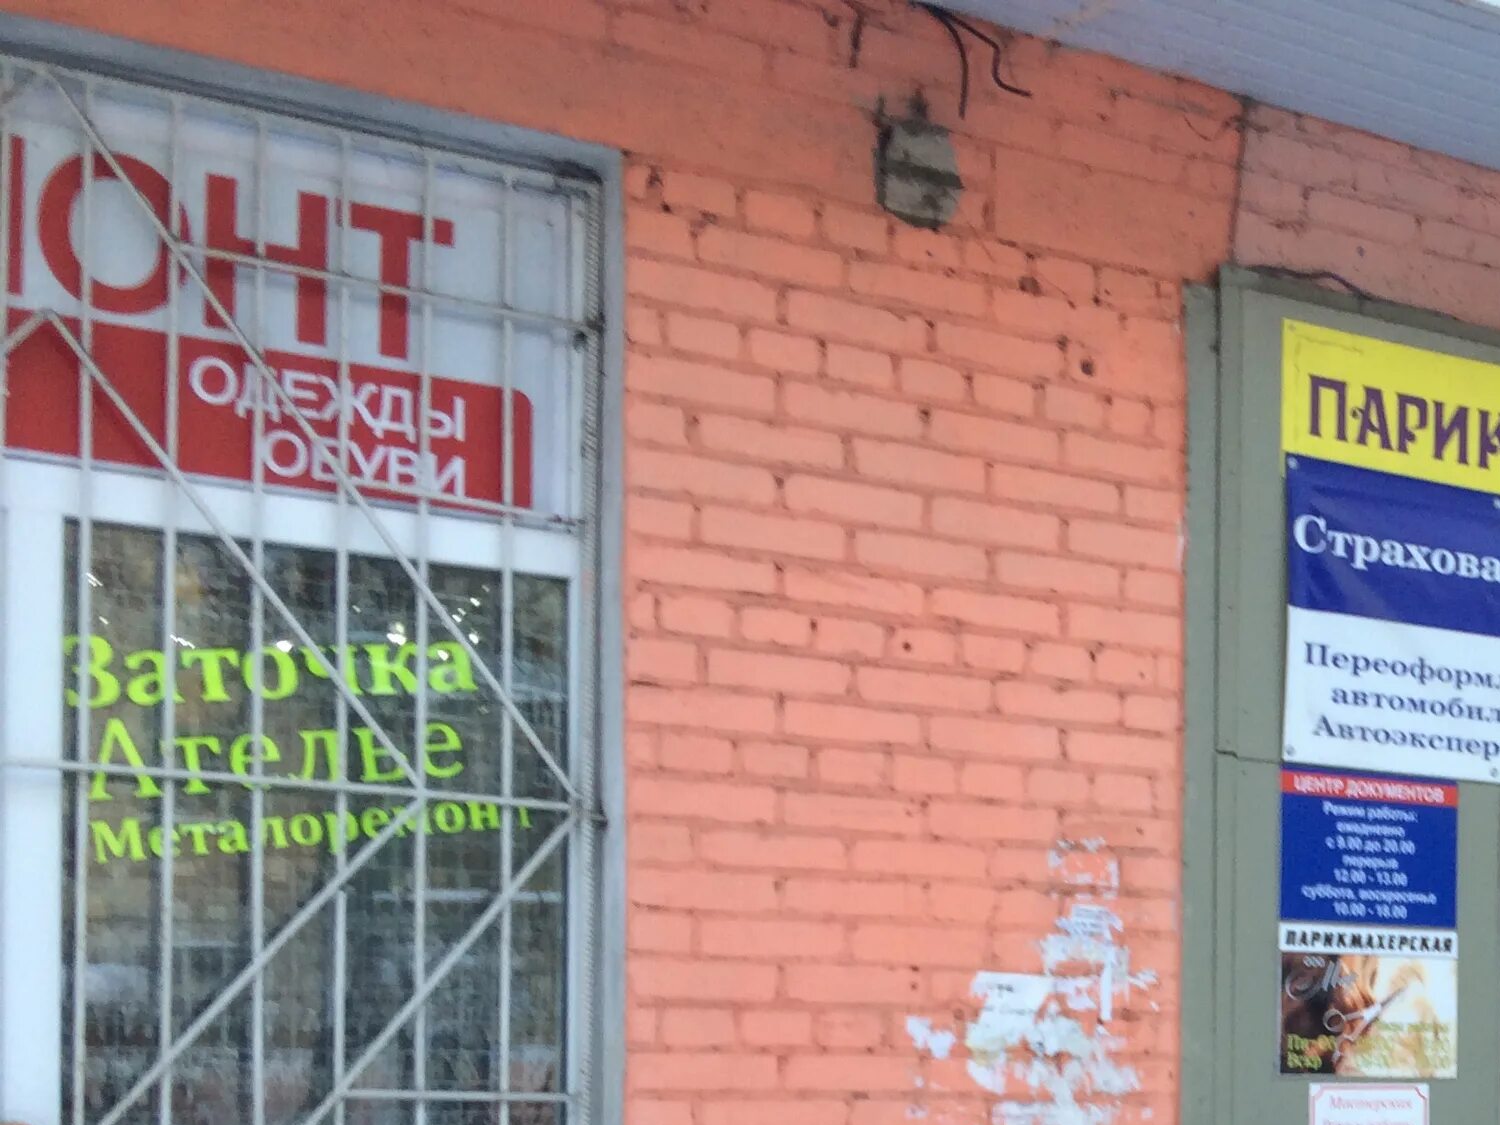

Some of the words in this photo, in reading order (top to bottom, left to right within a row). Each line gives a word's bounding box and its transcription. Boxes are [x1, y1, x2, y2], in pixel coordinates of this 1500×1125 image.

[8, 134, 455, 362] ОНТ
[188, 356, 466, 442] ОДЕЖДЫ
[263, 430, 466, 498] ОБУВИ
[62, 634, 478, 708] Заточка
[89, 718, 464, 799] Ателье
[1294, 775, 1344, 794] ЦЕНТР
[1346, 779, 1445, 803] ДОКУМЕНТОВ
[1285, 930, 1452, 952] ПАРИКМАХЕРСКАЯ
